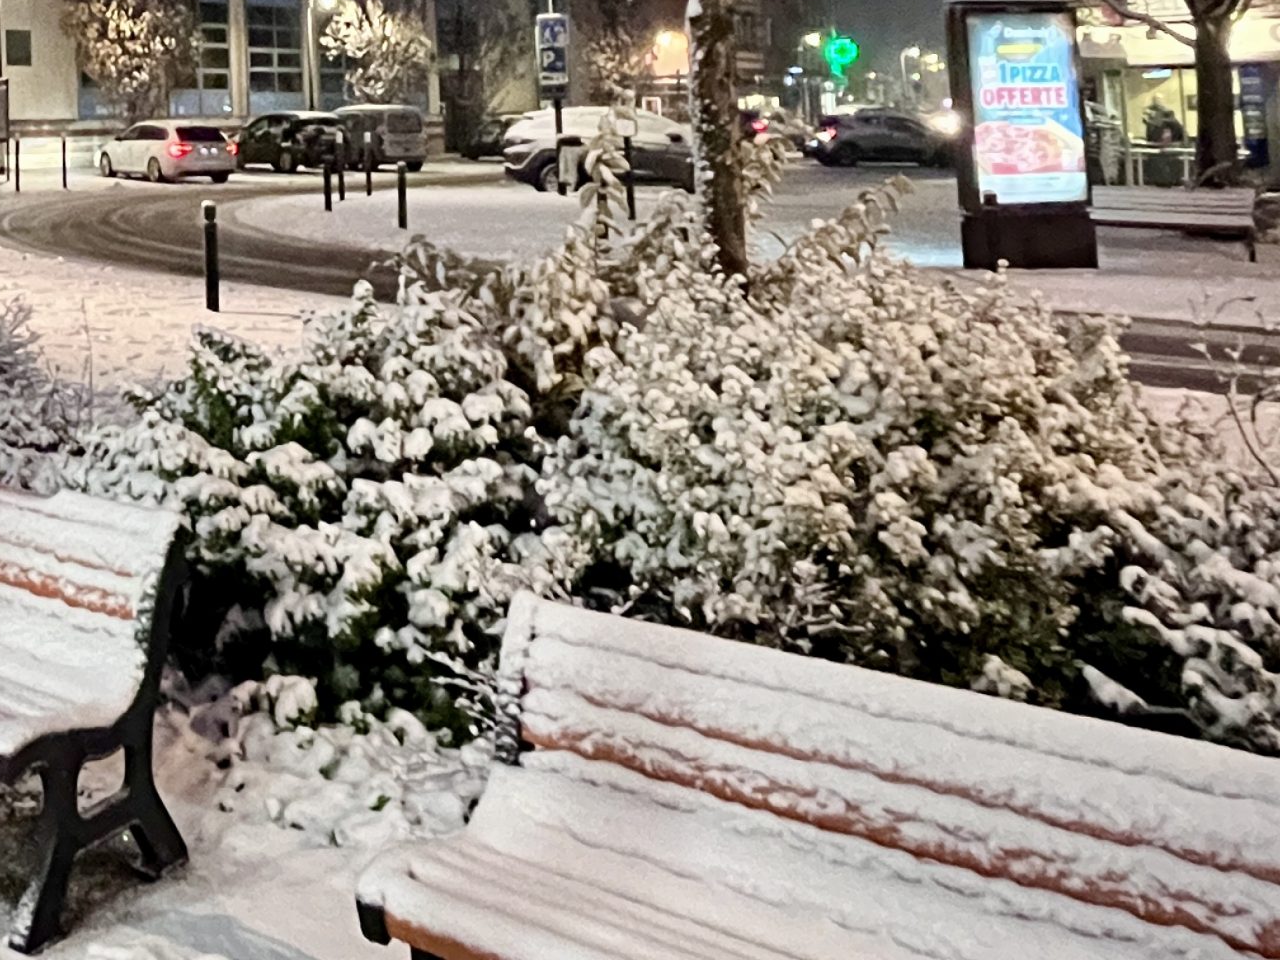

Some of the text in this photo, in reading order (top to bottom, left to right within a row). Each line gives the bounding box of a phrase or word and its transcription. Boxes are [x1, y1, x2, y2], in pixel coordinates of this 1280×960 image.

[999, 63, 1060, 83] 1 PIZZA
[983, 86, 1065, 106] OFFERTE
